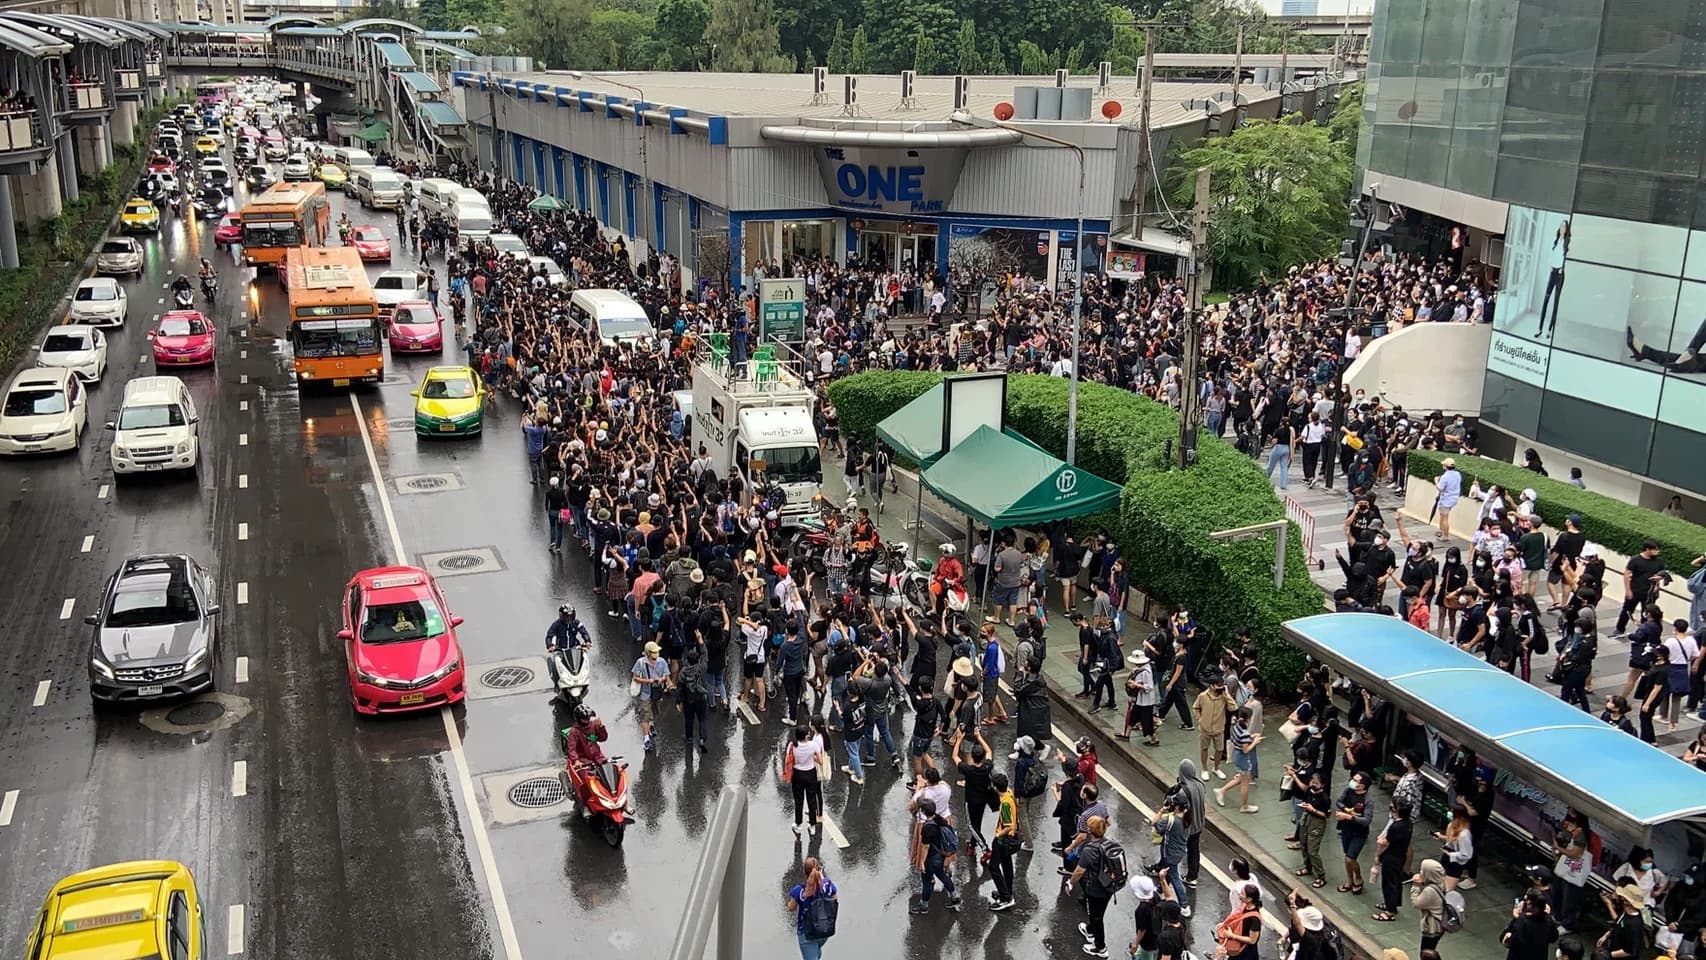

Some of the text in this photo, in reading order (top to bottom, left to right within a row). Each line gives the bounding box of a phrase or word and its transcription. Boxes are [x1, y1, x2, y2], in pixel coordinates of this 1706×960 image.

[837, 163, 925, 201] ONE
[911, 200, 945, 212] PARK
[1060, 247, 1073, 260] THE
[1058, 260, 1076, 271] LAST
